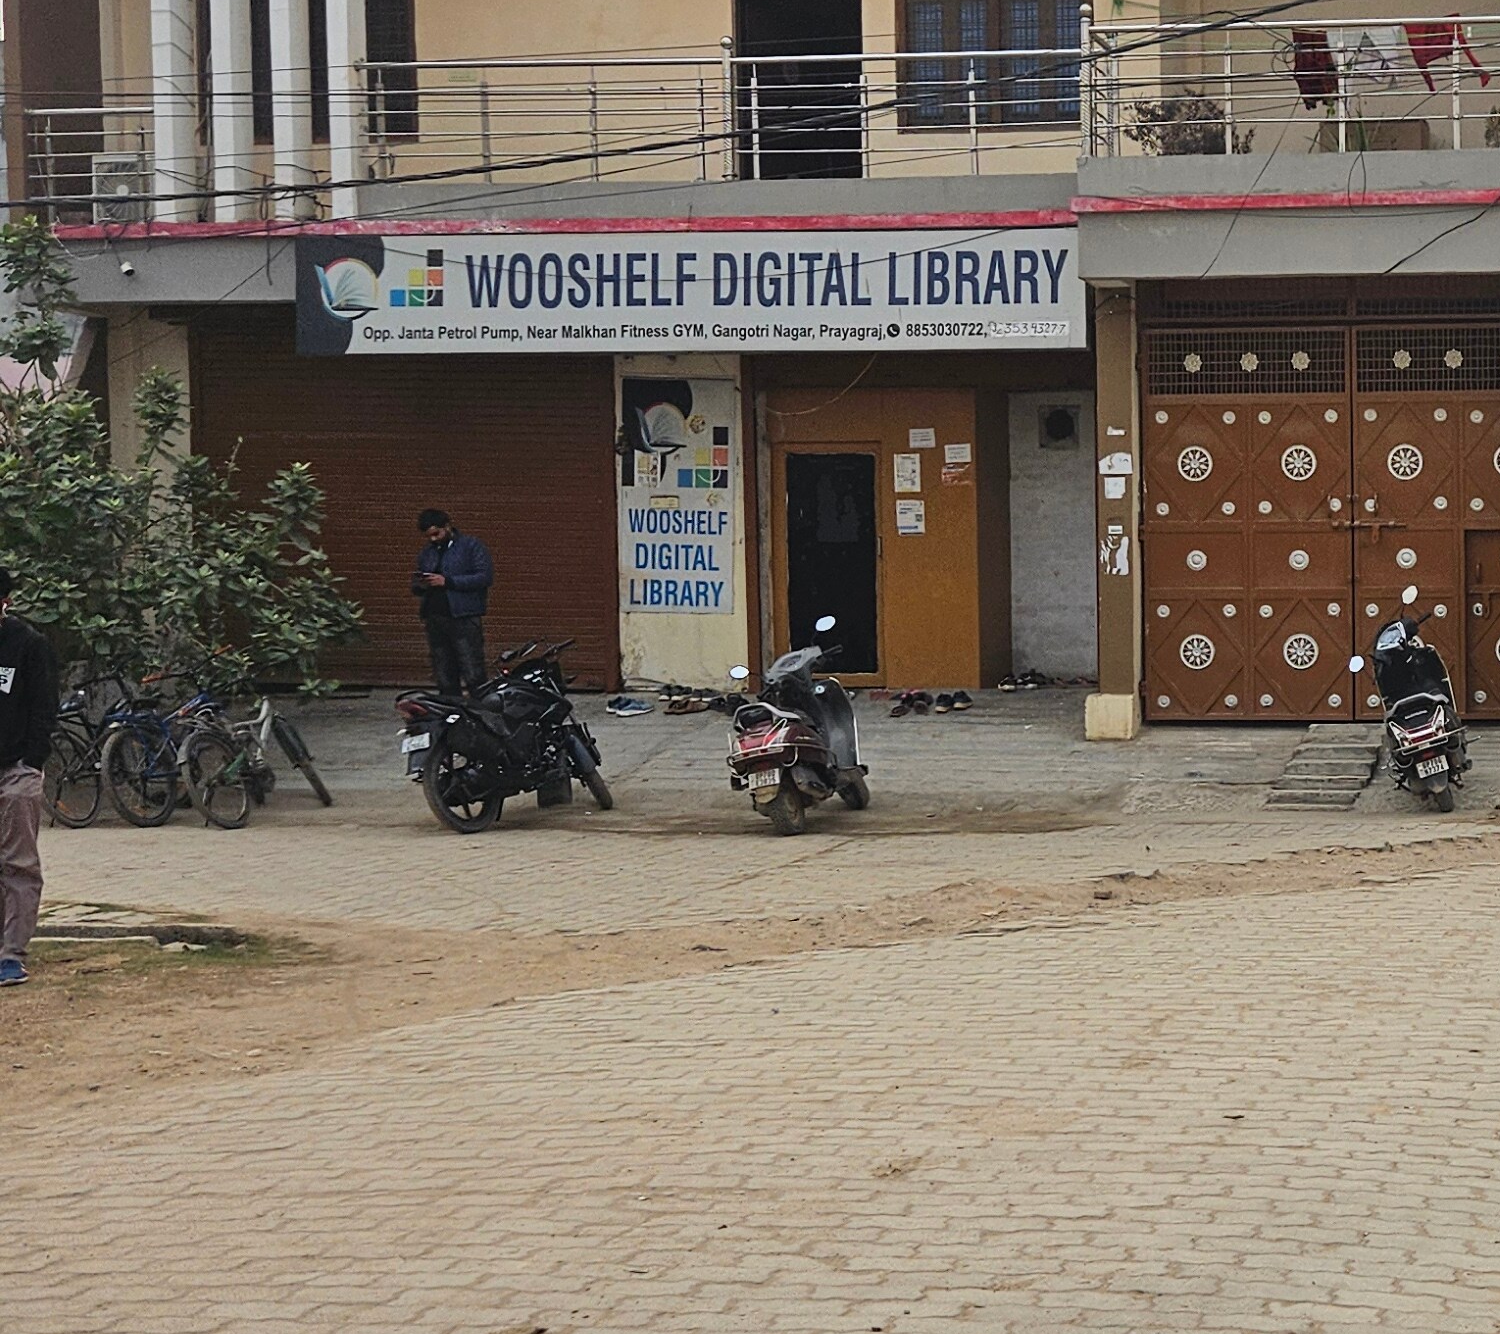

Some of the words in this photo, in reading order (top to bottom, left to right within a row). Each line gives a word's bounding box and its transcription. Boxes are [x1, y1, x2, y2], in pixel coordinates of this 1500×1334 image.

[465, 252, 697, 309] WOOSHELF
[713, 251, 872, 307] DIGITAL
[888, 249, 1069, 306] LIBRARY
[363, 326, 394, 342] Opp.
[398, 326, 434, 340] Janta
[438, 325, 477, 340] Petrol
[481, 325, 522, 341] Pump,
[527, 325, 558, 339] Near
[562, 325, 617, 339] Malkhan
[621, 324, 669, 338] Fitness
[673, 323, 708, 339] GYM,
[712, 324, 769, 340] Gangotri
[774, 323, 815, 340] Nagar,
[820, 323, 886, 340] Prayagraj,
[906, 322, 987, 338] 8853030722,
[628, 508, 728, 535] WOOSHELF
[635, 543, 719, 571] DIGITAL
[630, 579, 724, 607] LIBRARY
